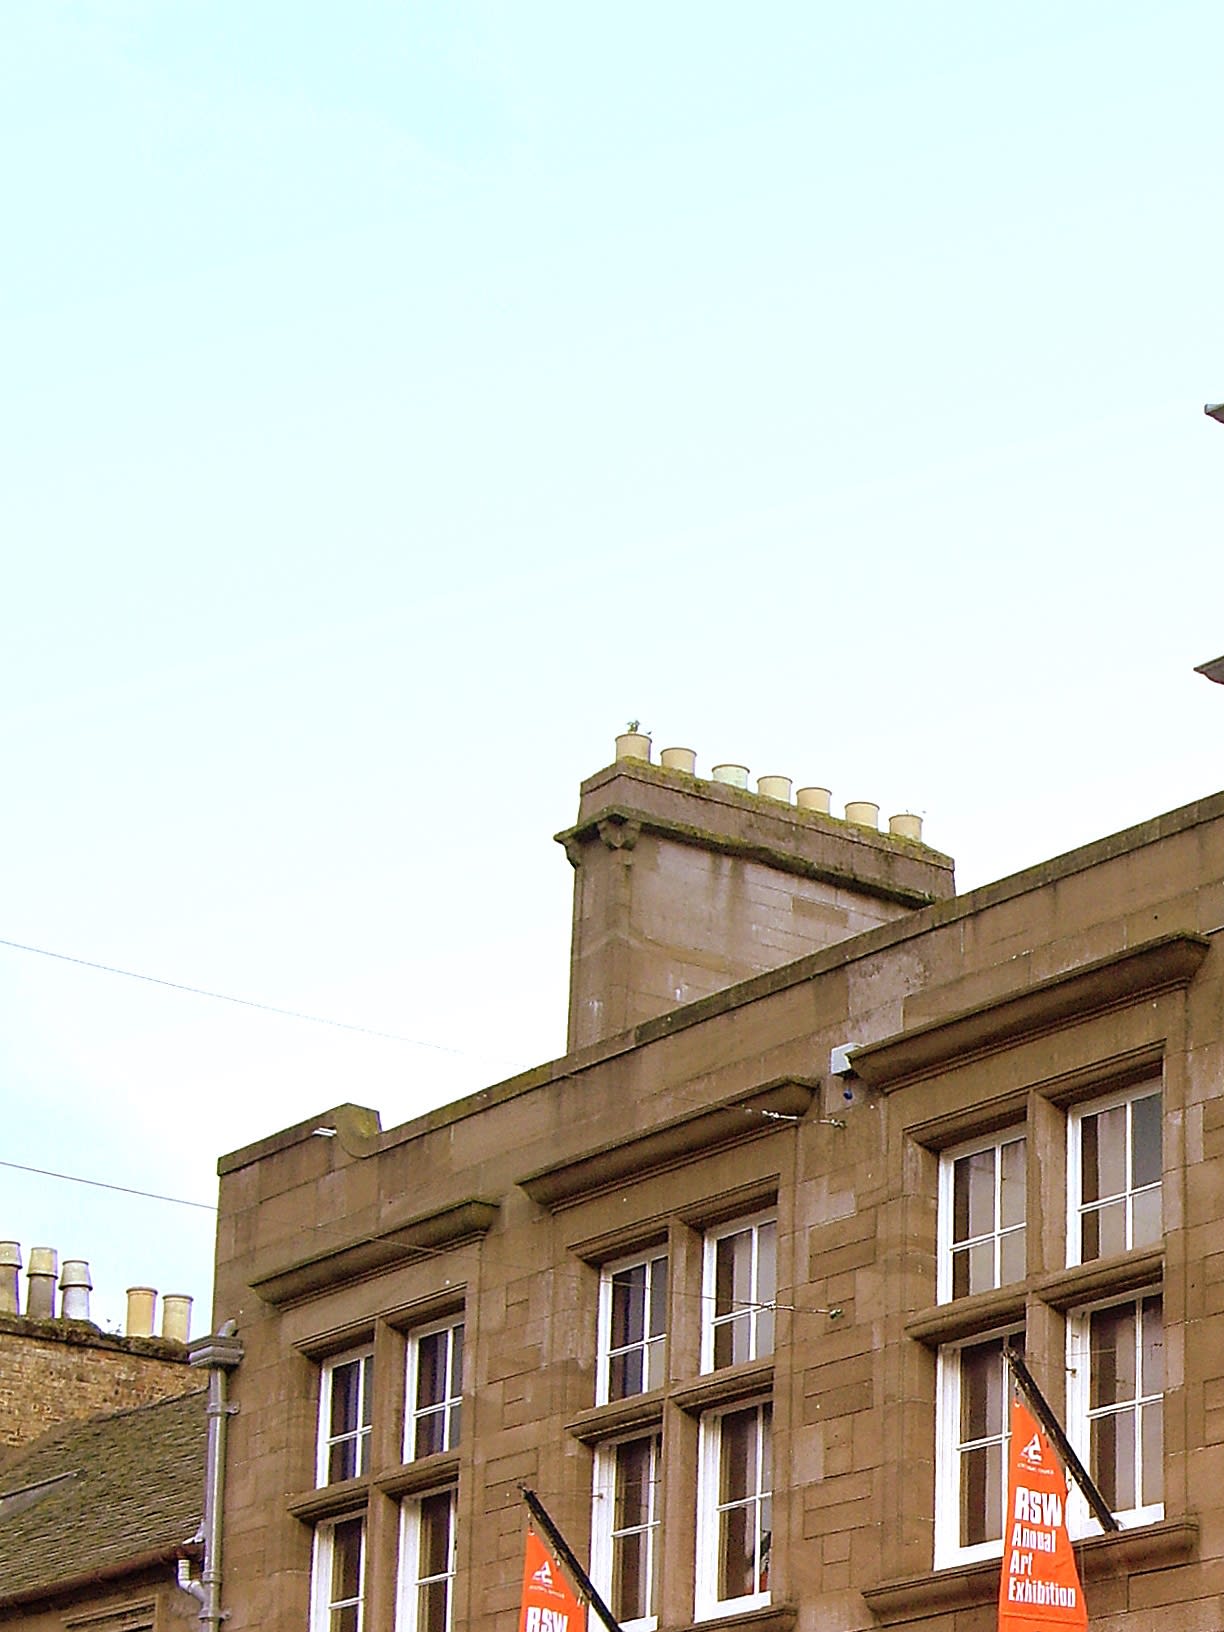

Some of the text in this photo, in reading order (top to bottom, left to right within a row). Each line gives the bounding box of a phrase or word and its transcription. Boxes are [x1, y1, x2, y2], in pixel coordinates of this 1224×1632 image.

[1014, 1486, 1063, 1527] RSW
[1011, 1523, 1056, 1553] Annual
[1010, 1550, 1033, 1576] Art
[1008, 1576, 1076, 1608] Exhibition
